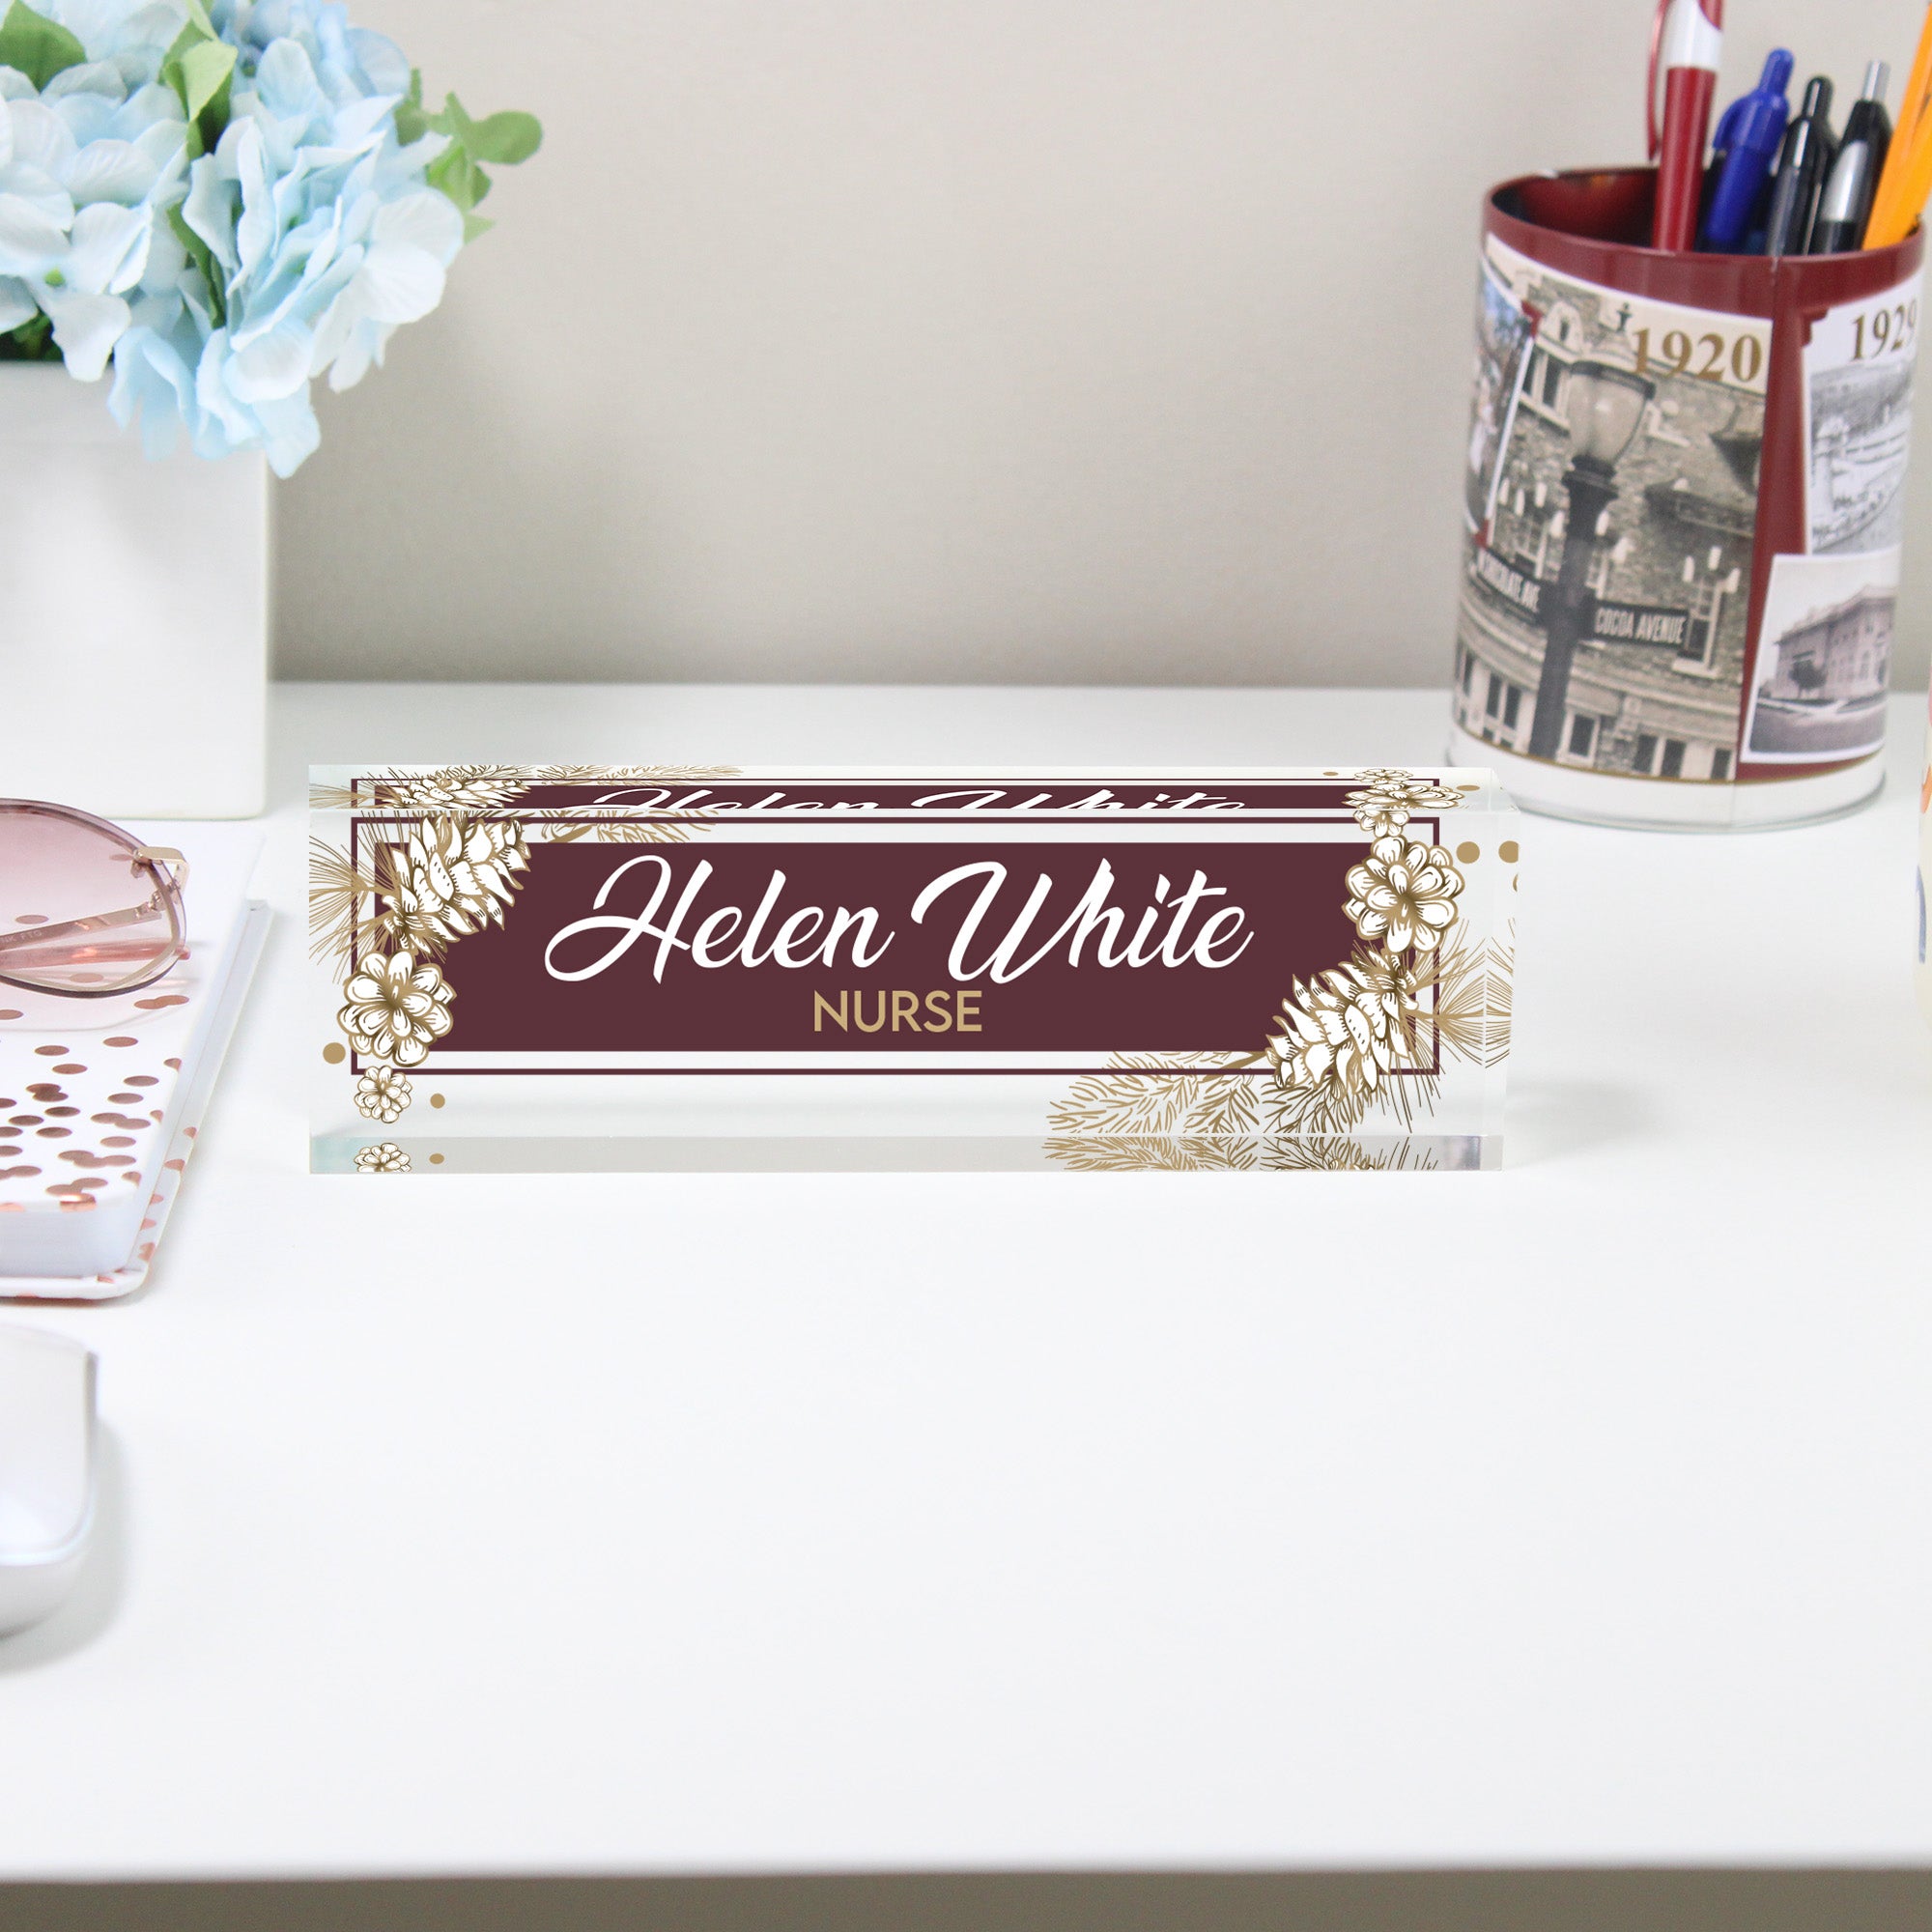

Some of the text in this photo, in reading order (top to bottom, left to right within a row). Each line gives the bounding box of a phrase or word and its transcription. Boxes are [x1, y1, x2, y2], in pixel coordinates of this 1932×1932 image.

[1633, 328, 1763, 383] 1920
[1594, 607, 1686, 645] COCOA AVENUE
[545, 855, 1255, 984] Helen White
[813, 990, 982, 1033] NURSE
